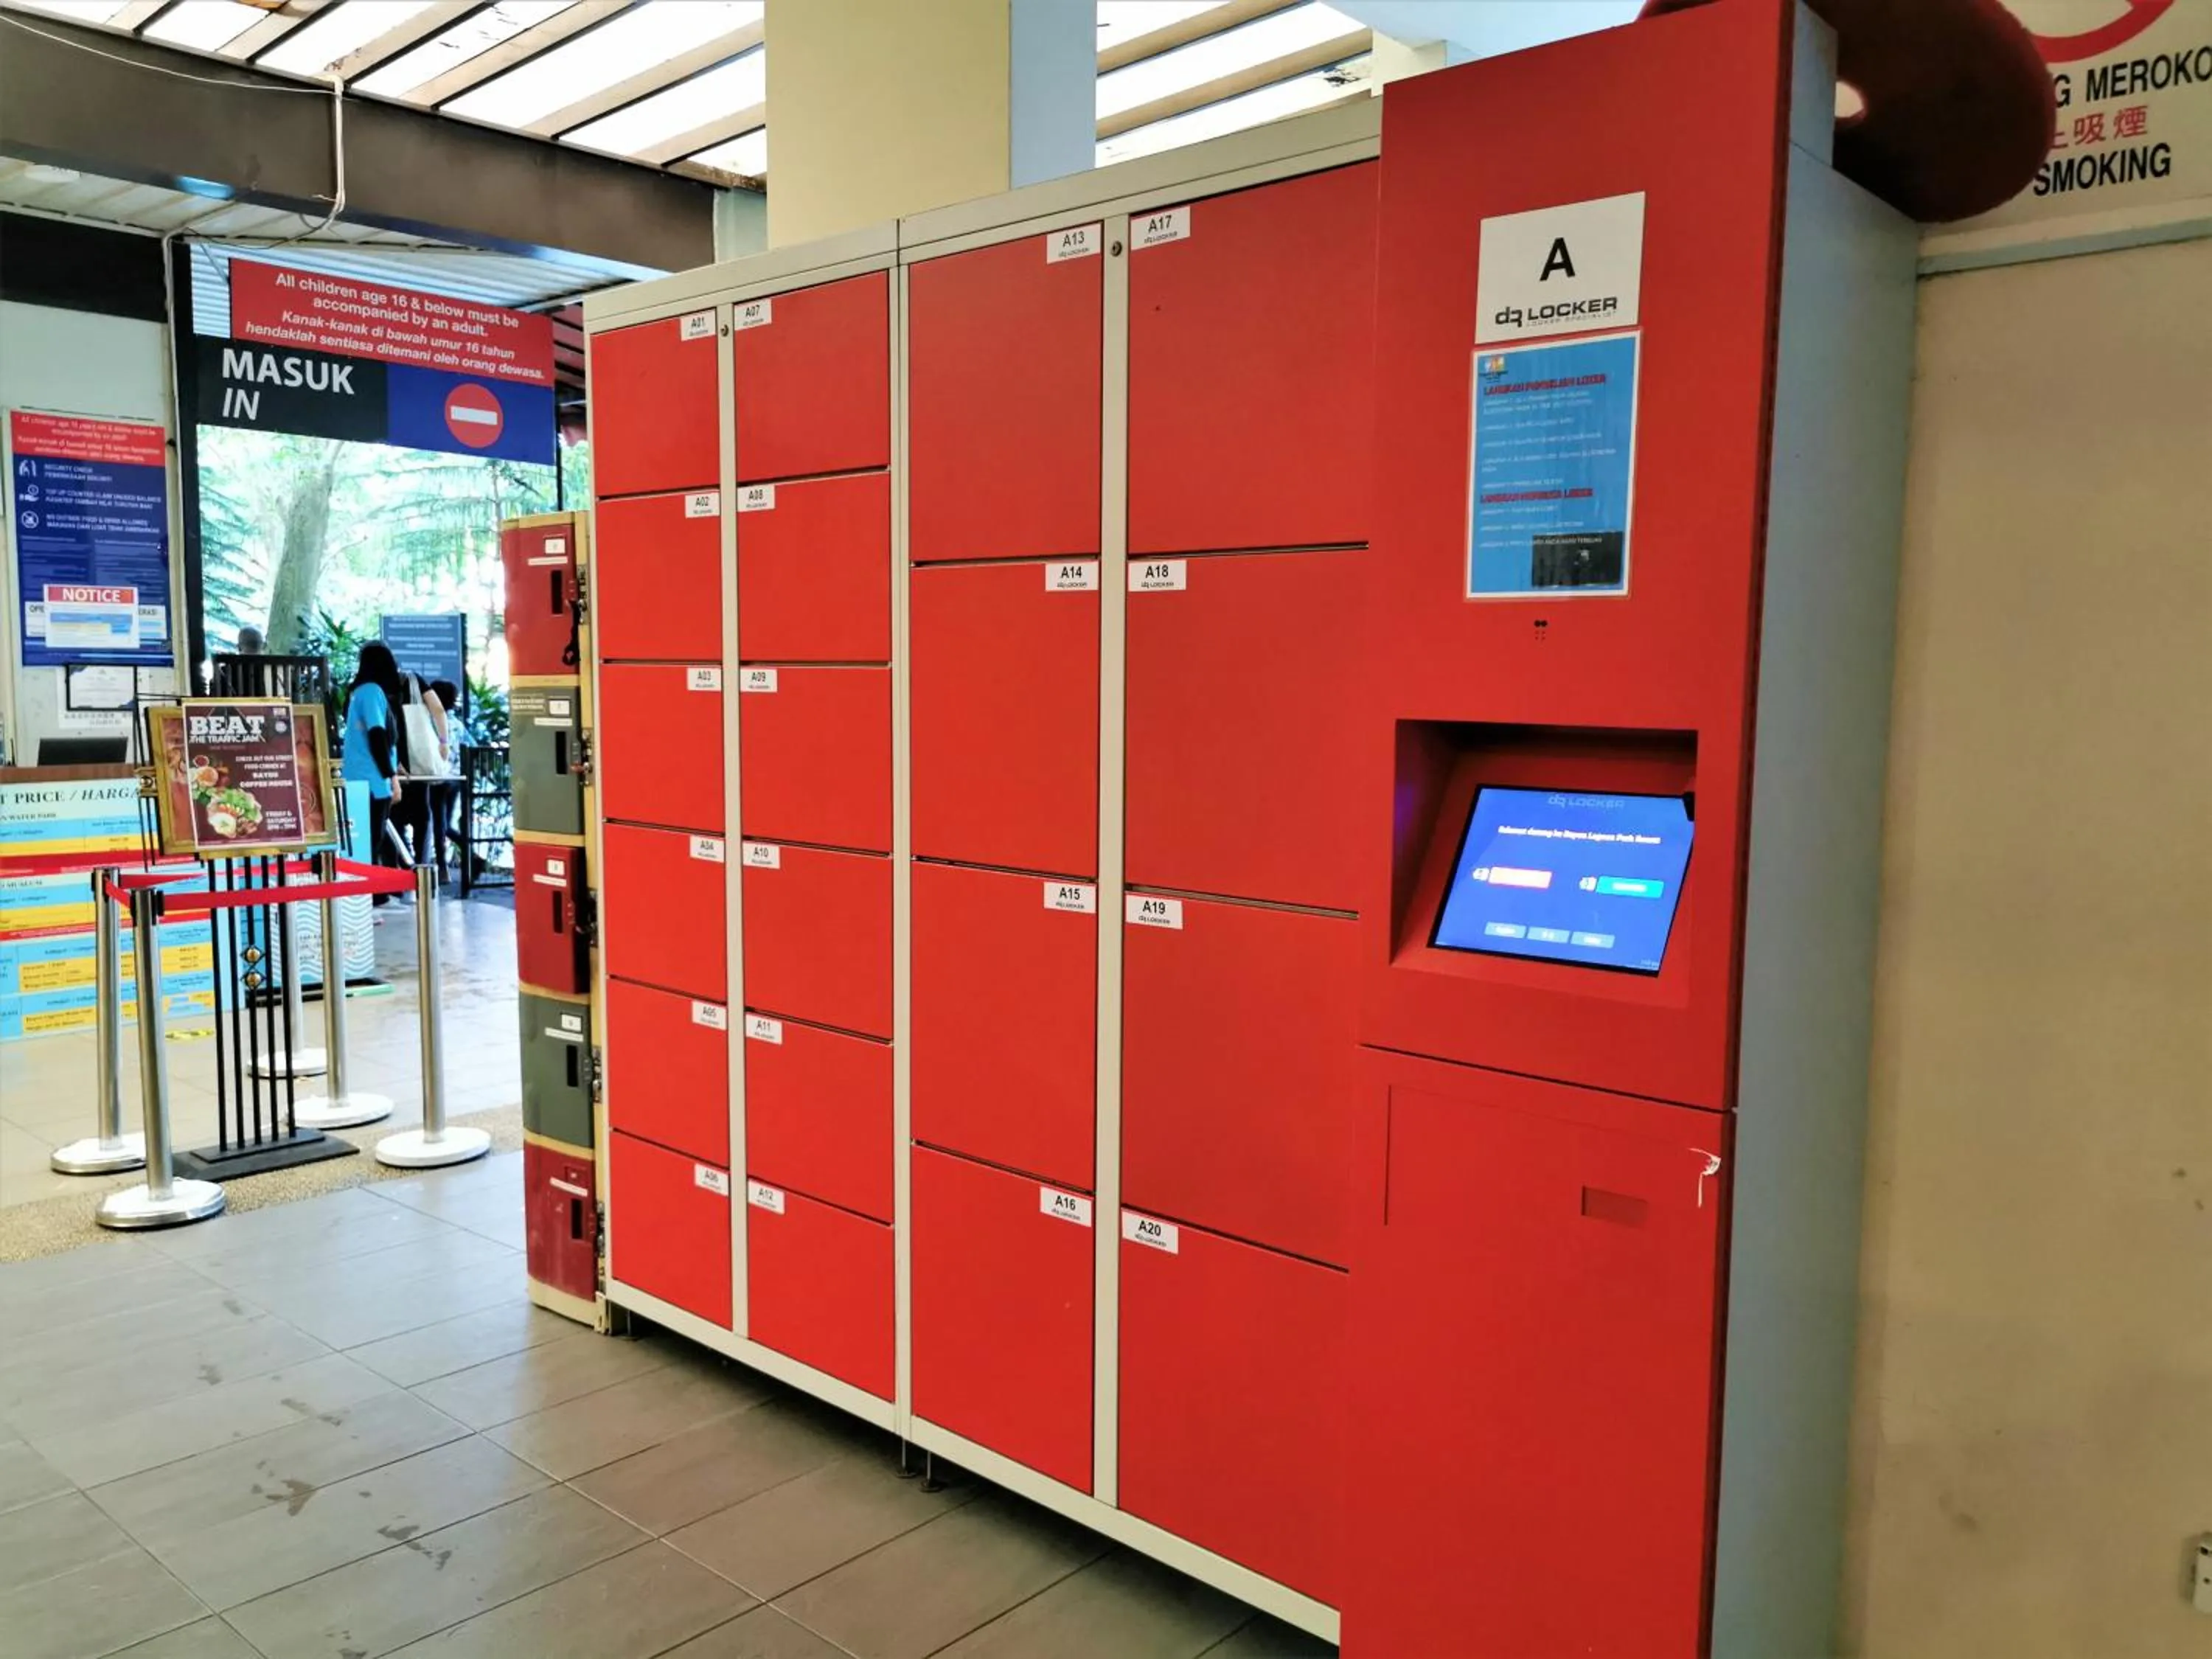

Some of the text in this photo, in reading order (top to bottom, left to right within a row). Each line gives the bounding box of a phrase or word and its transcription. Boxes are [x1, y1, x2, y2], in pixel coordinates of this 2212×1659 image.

[2086, 46, 2212, 102] MEROKO
[2033, 142, 2171, 196] SMOKING
[1148, 215, 1172, 233] A17
[1062, 231, 1085, 247] A13
[1540, 237, 1576, 281] A
[275, 273, 519, 328] All children age 16 & below must be
[1527, 296, 1618, 321] LOCKER
[313, 297, 489, 336] accompanied by an adult.
[282, 310, 515, 360] Kanak-kanak di bawah umur 16 tahun
[246, 321, 544, 380] hendaklah sentiasa ditemani oleh orang dewasa.
[222, 347, 355, 395] MASUK
[222, 388, 260, 421] IN
[1061, 566, 1082, 579] A14
[1145, 564, 1169, 579] A18
[63, 588, 120, 602] NOTICE
[189, 715, 265, 735] BEAT
[15, 790, 65, 804] PRICE
[1568, 797, 1626, 809] LOCKER
[1059, 887, 1081, 900] A15
[1142, 900, 1166, 914] A19
[756, 1020, 771, 1031] A11
[1055, 1195, 1077, 1211] A16
[1138, 1220, 1161, 1237] A20
